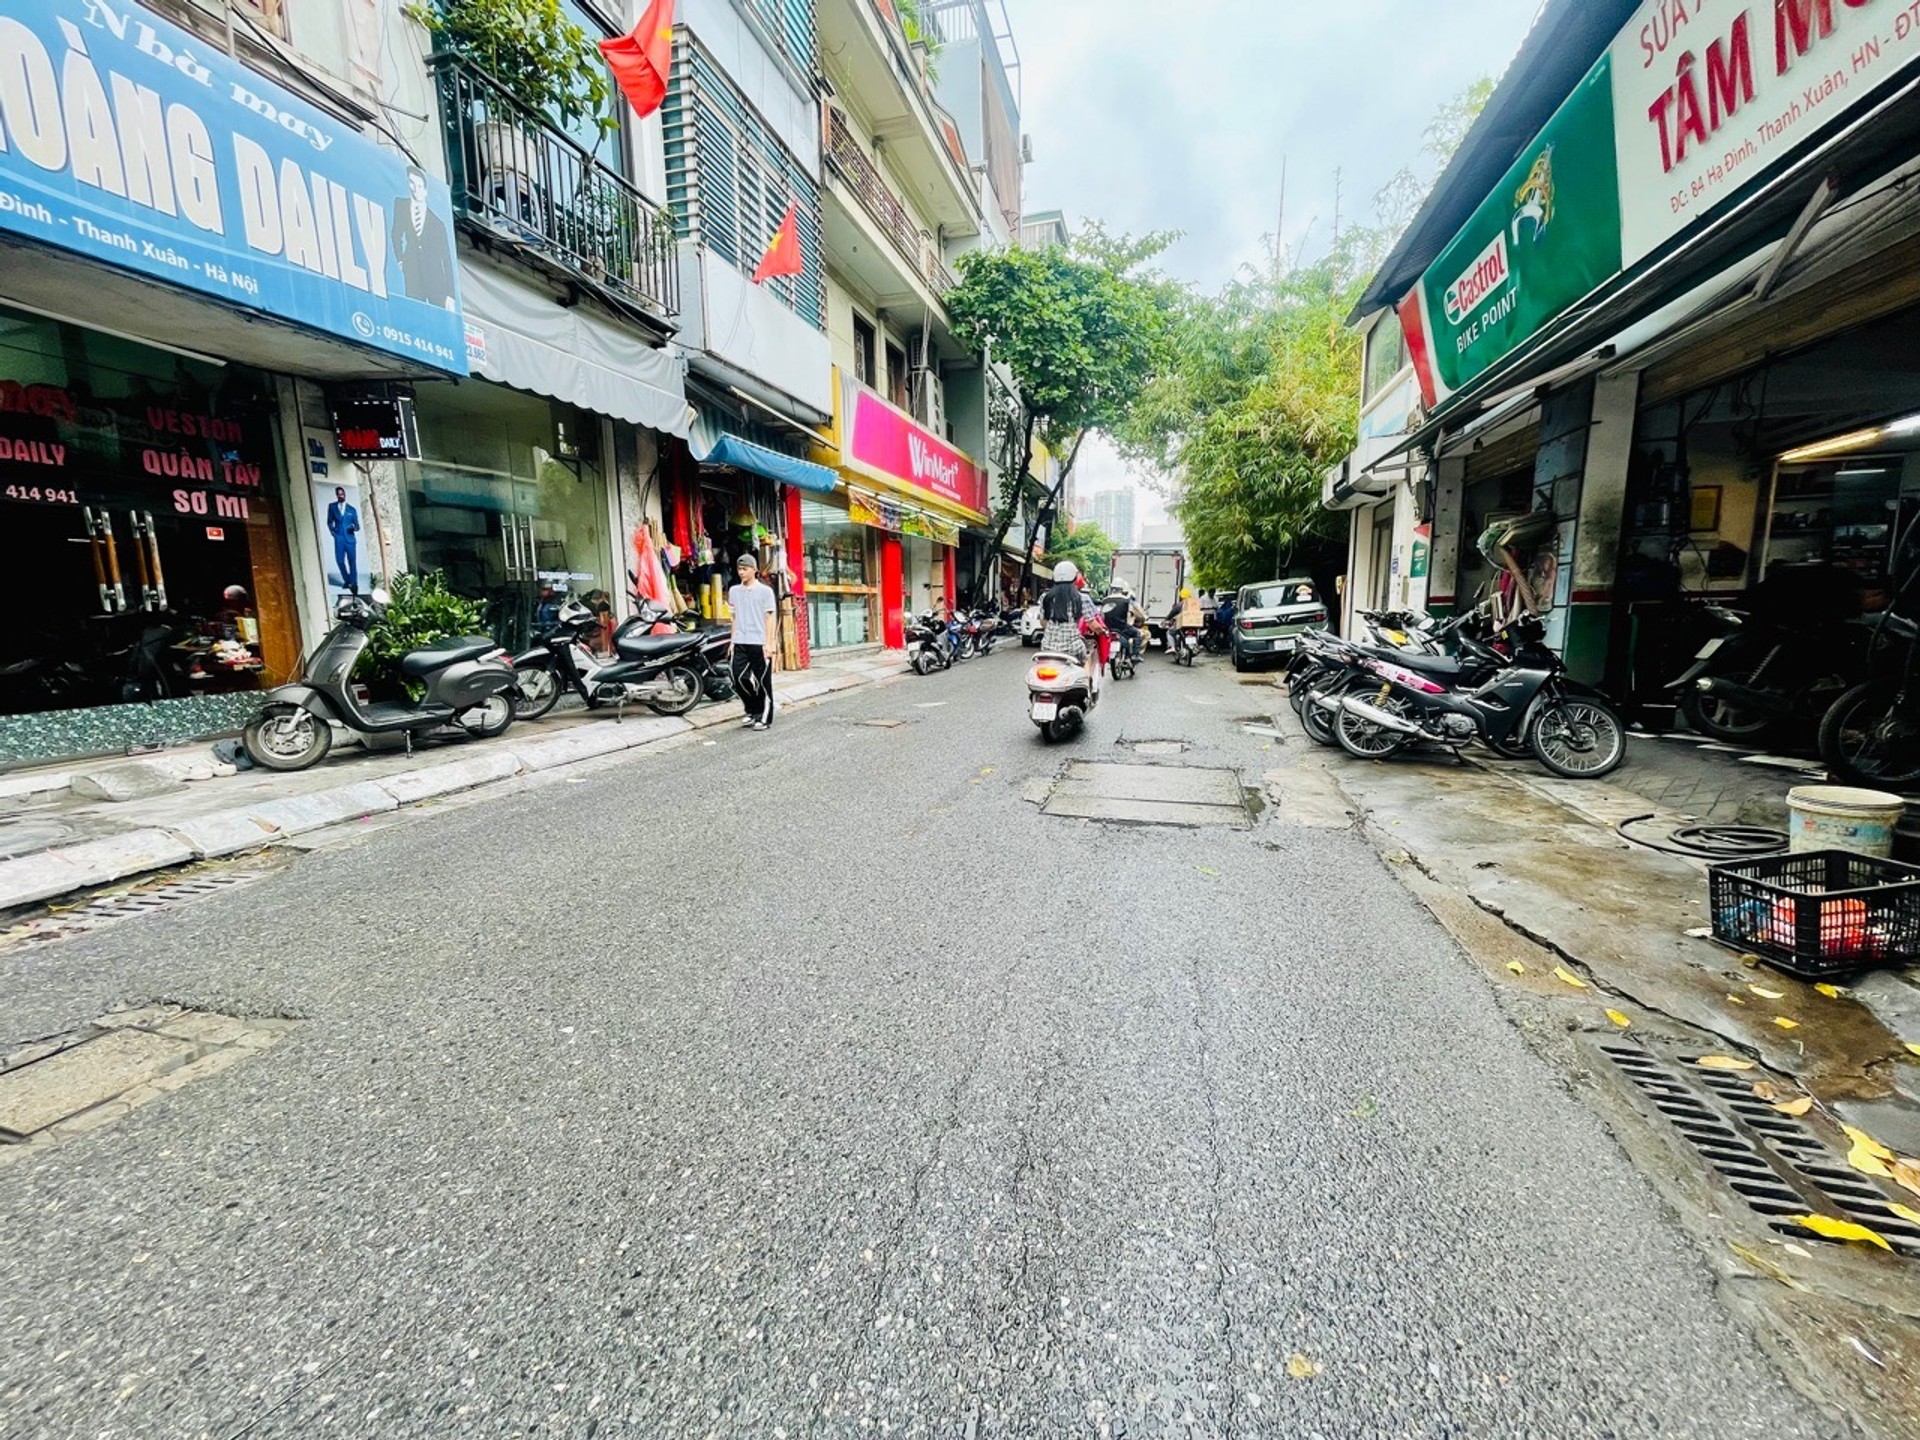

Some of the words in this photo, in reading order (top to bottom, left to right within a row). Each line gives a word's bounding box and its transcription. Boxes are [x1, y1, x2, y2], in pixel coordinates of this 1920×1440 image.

[83, 0, 212, 88] Nhà
[228, 81, 334, 152] may
[1648, 8, 1757, 174] TÂM
[1690, 175, 1705, 198] 84
[1706, 164, 1724, 185] Hạ
[1756, 101, 1802, 145] Thanh
[1802, 69, 1849, 113] Xuân,
[1851, 34, 1881, 74] HN
[0, 15, 226, 236] OÀNG
[231, 131, 389, 300] DAILY
[0, 191, 53, 225] Đình
[72, 215, 138, 253] Thanh
[141, 239, 190, 271] Xuân
[204, 261, 229, 284] Hà
[231, 270, 259, 295] Nội
[1458, 242, 1505, 312] Castrol
[383, 325, 412, 346] 0915
[413, 337, 434, 354] 414
[435, 344, 455, 361] 941
[1457, 321, 1479, 354] BIKE
[1482, 286, 1517, 332] POINT
[0, 436, 66, 467] DAILY
[146, 406, 243, 444] VESTON
[6, 484, 41, 501] 414
[44, 487, 79, 504] 941
[172, 488, 209, 516] SƠ
[214, 493, 249, 520] MI
